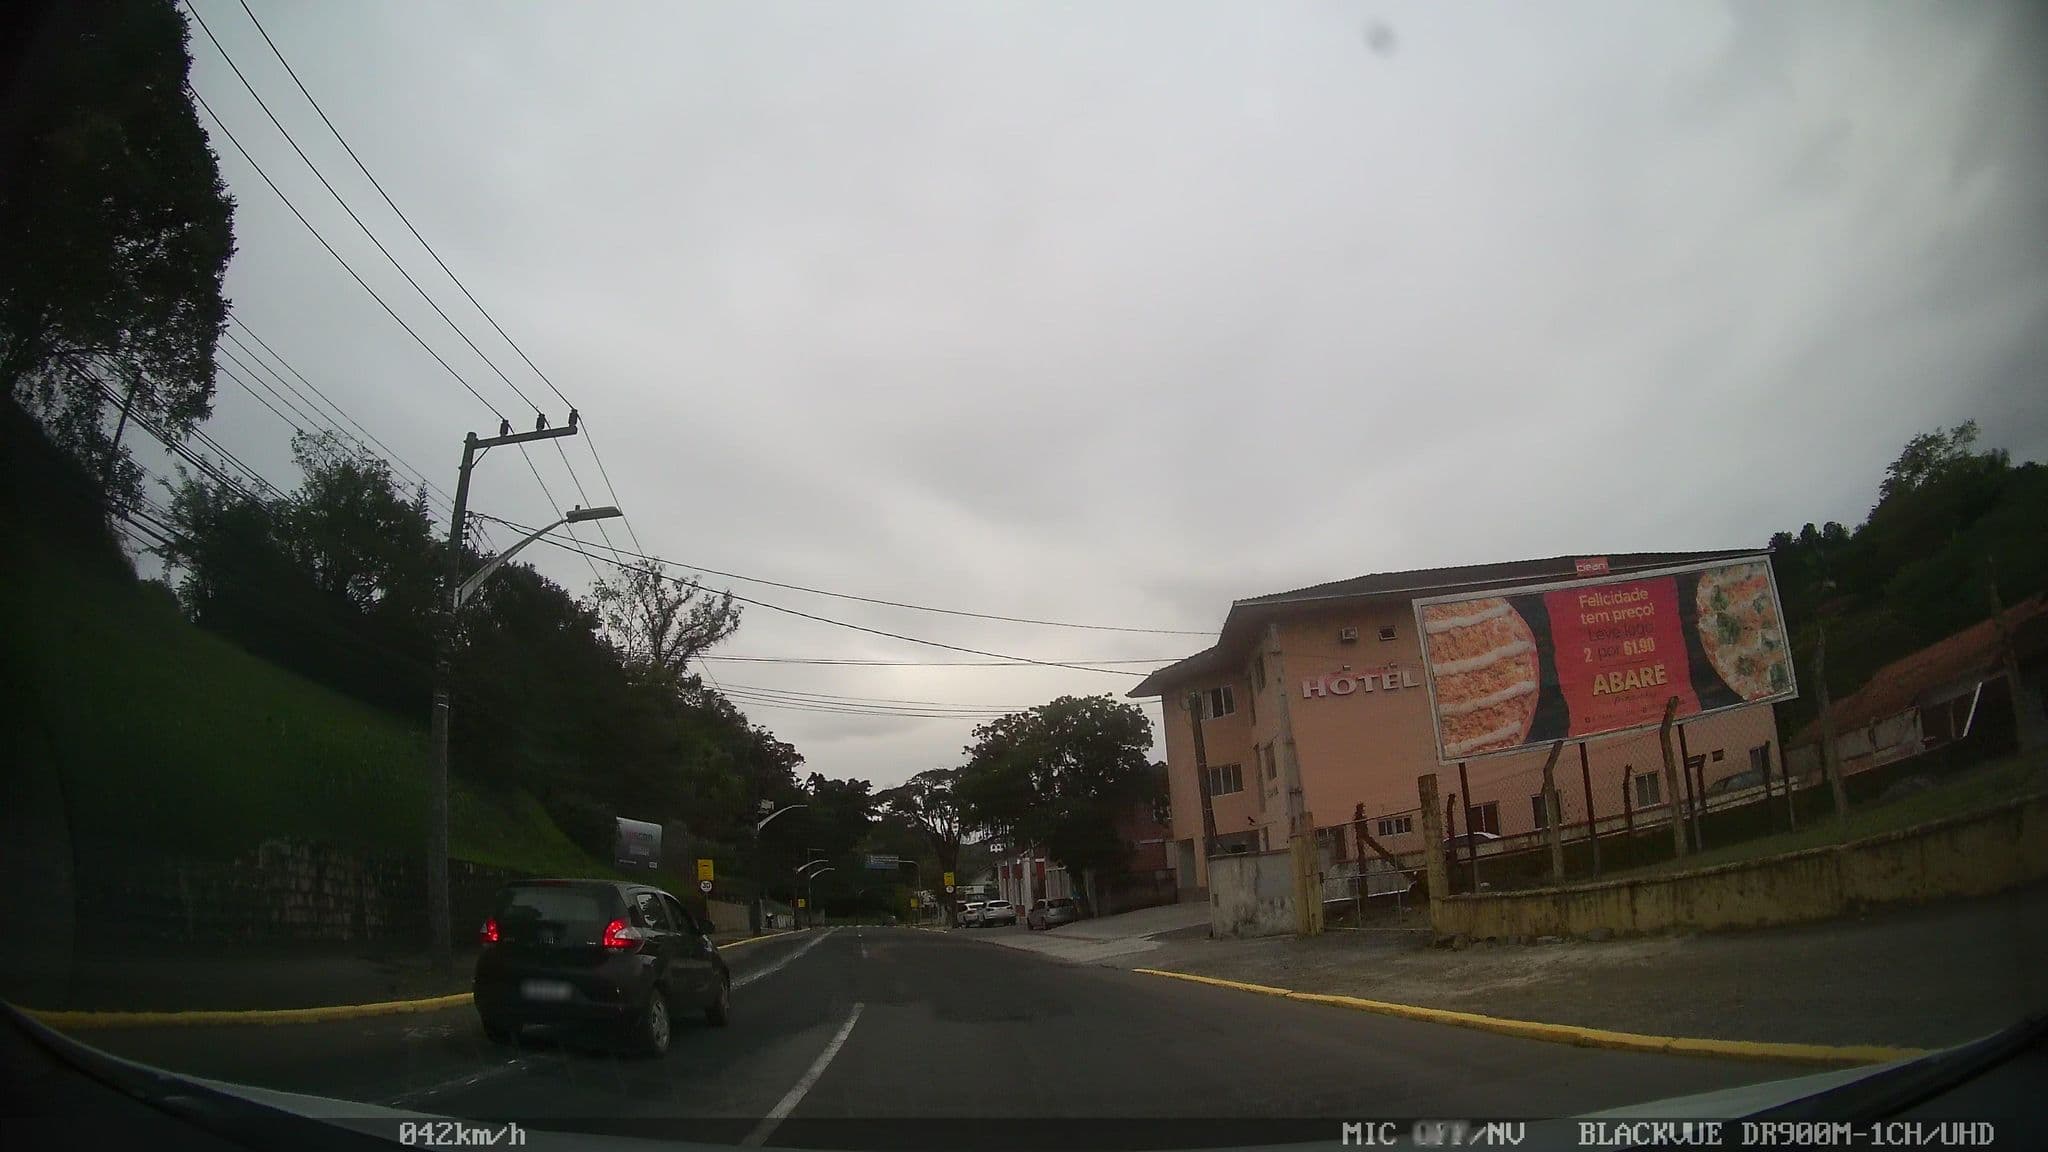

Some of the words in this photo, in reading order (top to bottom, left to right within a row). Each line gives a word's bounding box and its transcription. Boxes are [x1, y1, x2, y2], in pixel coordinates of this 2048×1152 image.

[1578, 588, 1648, 608] Felicidade
[1581, 610, 1610, 624] tem
[1612, 602, 1655, 623] preço!
[1583, 647, 1593, 664] 2
[1302, 671, 1420, 698] HOTEL
